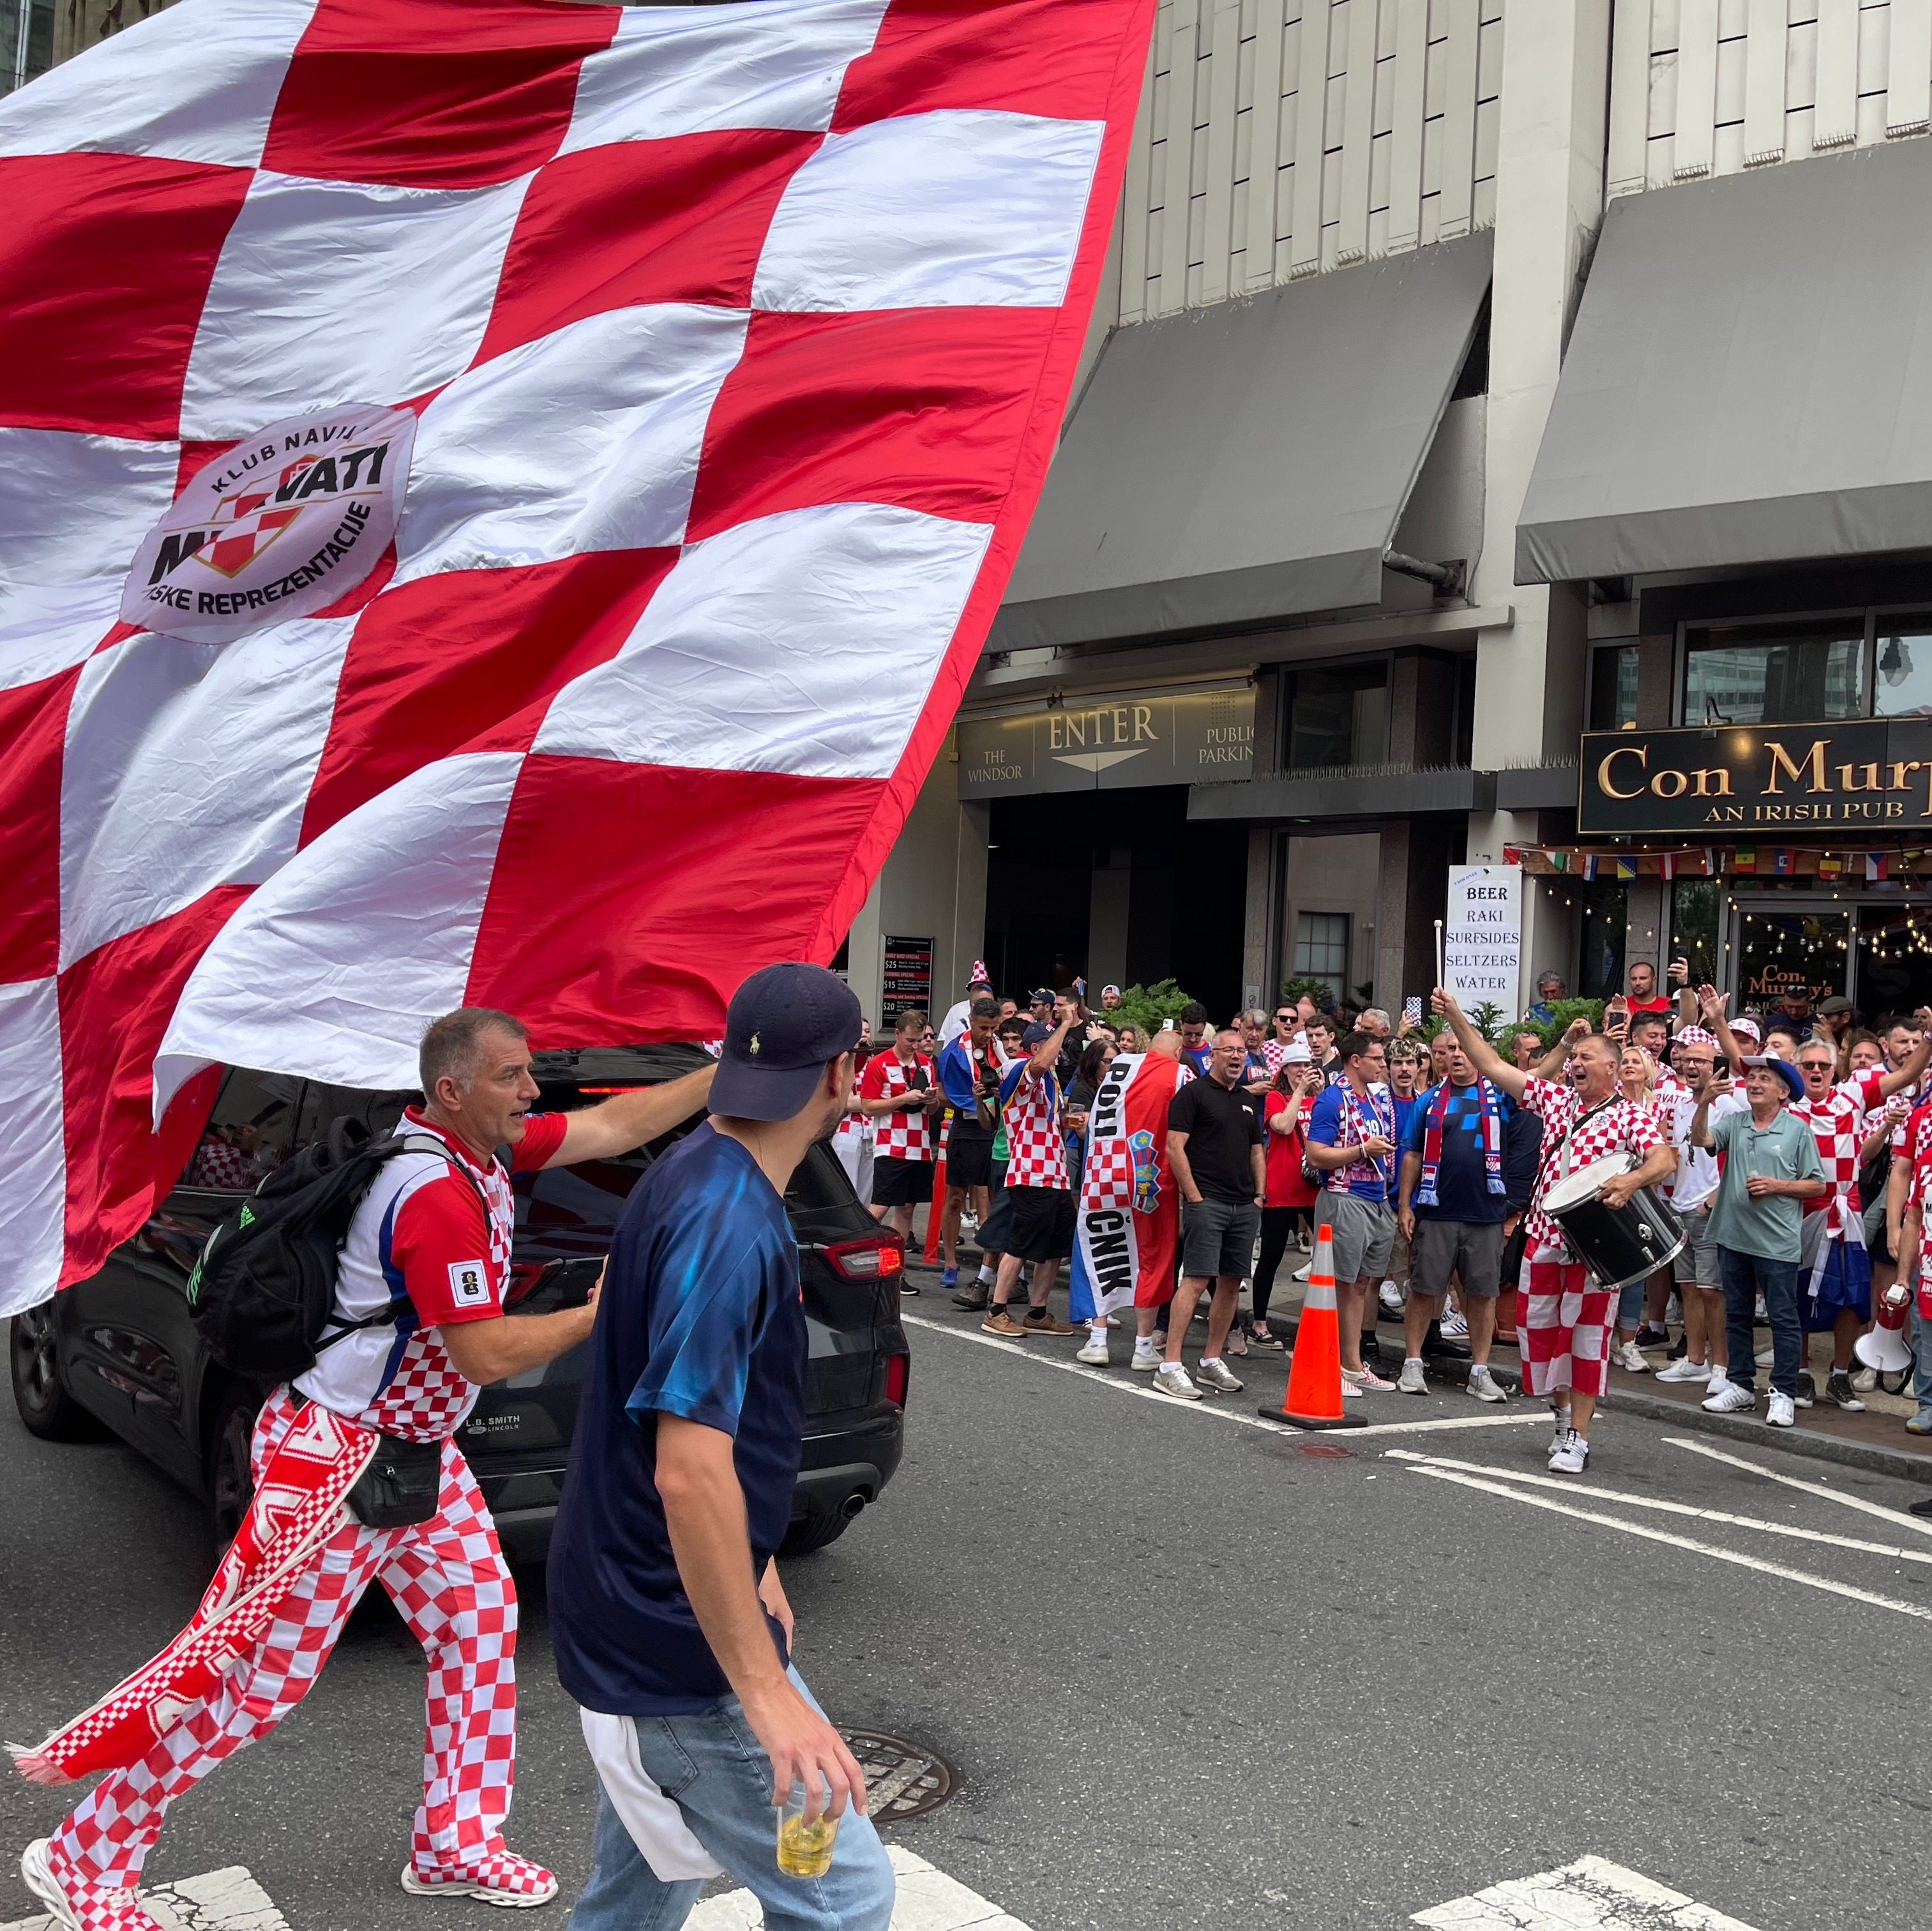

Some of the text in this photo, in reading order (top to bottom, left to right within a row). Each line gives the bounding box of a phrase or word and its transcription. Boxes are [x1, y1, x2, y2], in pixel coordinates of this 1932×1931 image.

[211, 444, 275, 493] KLUB
[144, 500, 371, 614] SKE REPREZENTACIJE
[1048, 706, 1159, 750] ENTER
[984, 750, 1006, 764] THE
[1198, 746, 1254, 764] PARKIN
[968, 766, 1023, 782] WINDSOR
[1598, 744, 1735, 799] Con
[1703, 802, 1904, 822] AN IRISH PUB
[1467, 887, 1508, 900] BEER
[1467, 910, 1503, 922] RAKI
[1446, 932, 1519, 944] SURFSIDES
[885, 960, 897, 969] $25
[1445, 955, 1517, 967] SELTZERS
[1763, 964, 1799, 982] Con
[884, 980, 896, 989] $15
[1455, 975, 1506, 989] WATER
[1748, 976, 1832, 1001] Mury's
[883, 1002, 894, 1011] $20
[1094, 1063, 1131, 1137] POLI
[465, 1415, 520, 1427] L.B. SMITH
